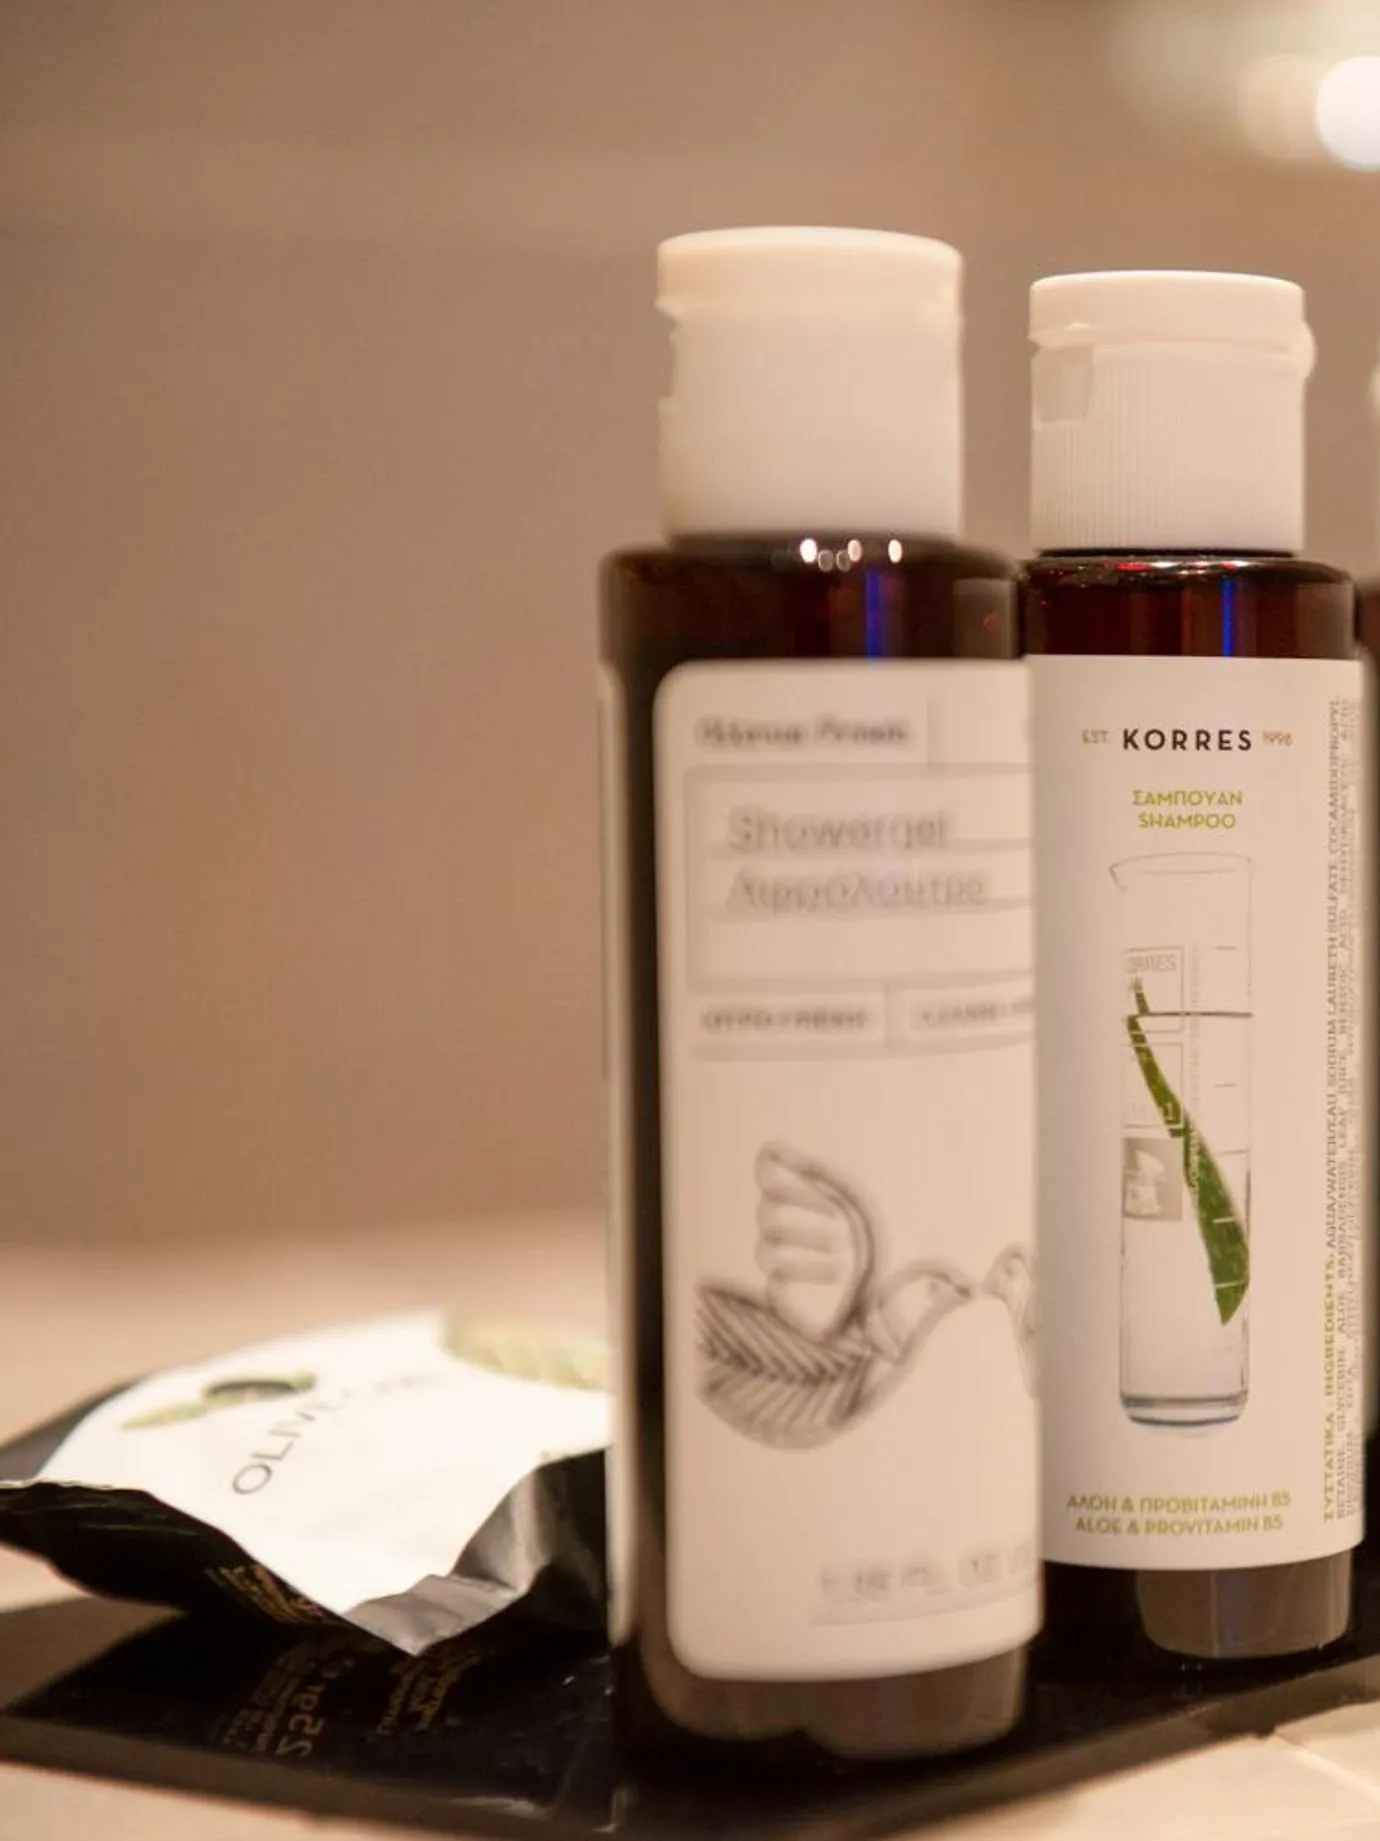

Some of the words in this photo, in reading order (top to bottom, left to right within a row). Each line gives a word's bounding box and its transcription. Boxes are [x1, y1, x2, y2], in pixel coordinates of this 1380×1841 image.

[1122, 728, 1252, 751] KORRES
[1132, 790, 1243, 806] ΣΑΜΠΟΥΑΝ
[1138, 813, 1237, 829] SHAMPOO
[1075, 1517, 1121, 1533] ALOE
[1145, 1516, 1258, 1536] PROVITAMIN
